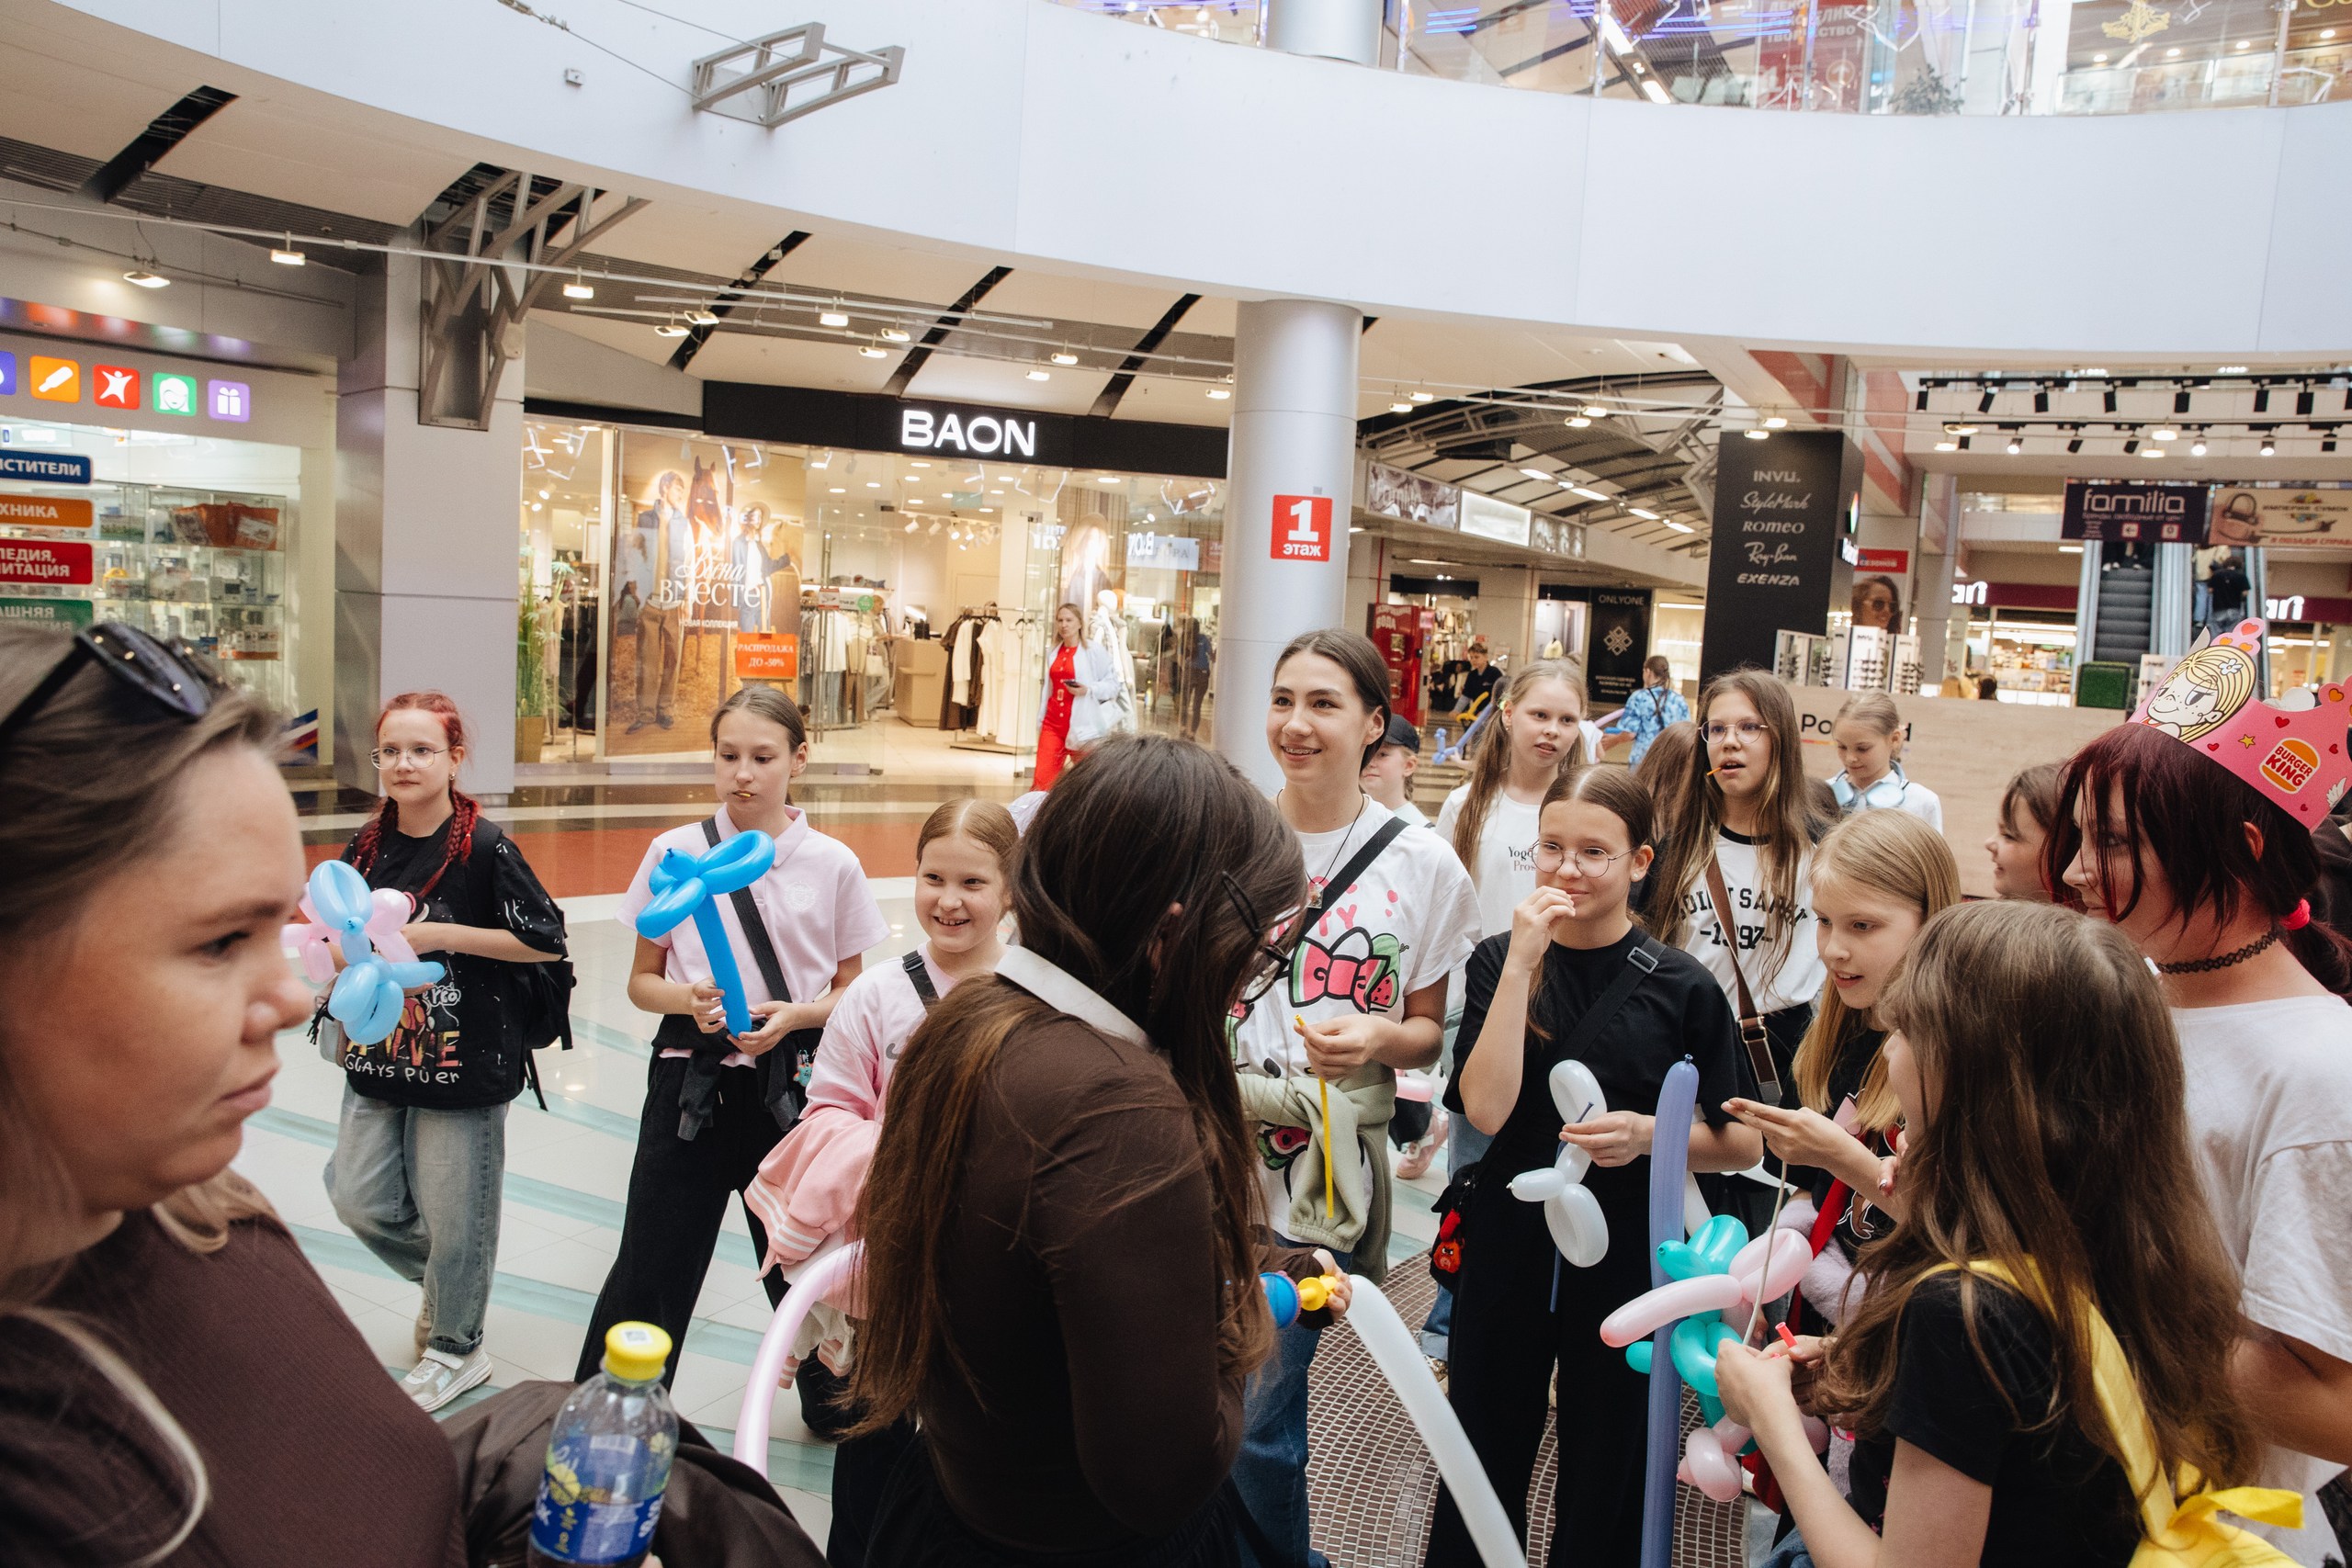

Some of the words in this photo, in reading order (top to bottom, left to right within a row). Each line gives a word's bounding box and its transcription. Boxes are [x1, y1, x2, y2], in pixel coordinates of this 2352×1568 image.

[901, 409, 1035, 457] BAON
[2083, 488, 2186, 513] familia
[1288, 500, 1318, 542] 1
[1283, 544, 1321, 557] этаж
[1745, 541, 1798, 568] Ray-Ban
[1737, 573, 1800, 586] EXENZA
[1599, 594, 1645, 606] ONLYONE
[738, 644, 794, 653] РАСПРОДАЖА
[749, 658, 763, 668] ДО
[2266, 754, 2306, 786] KING
[2275, 746, 2313, 777] BURGER
[1700, 921, 1773, 950] -197-
